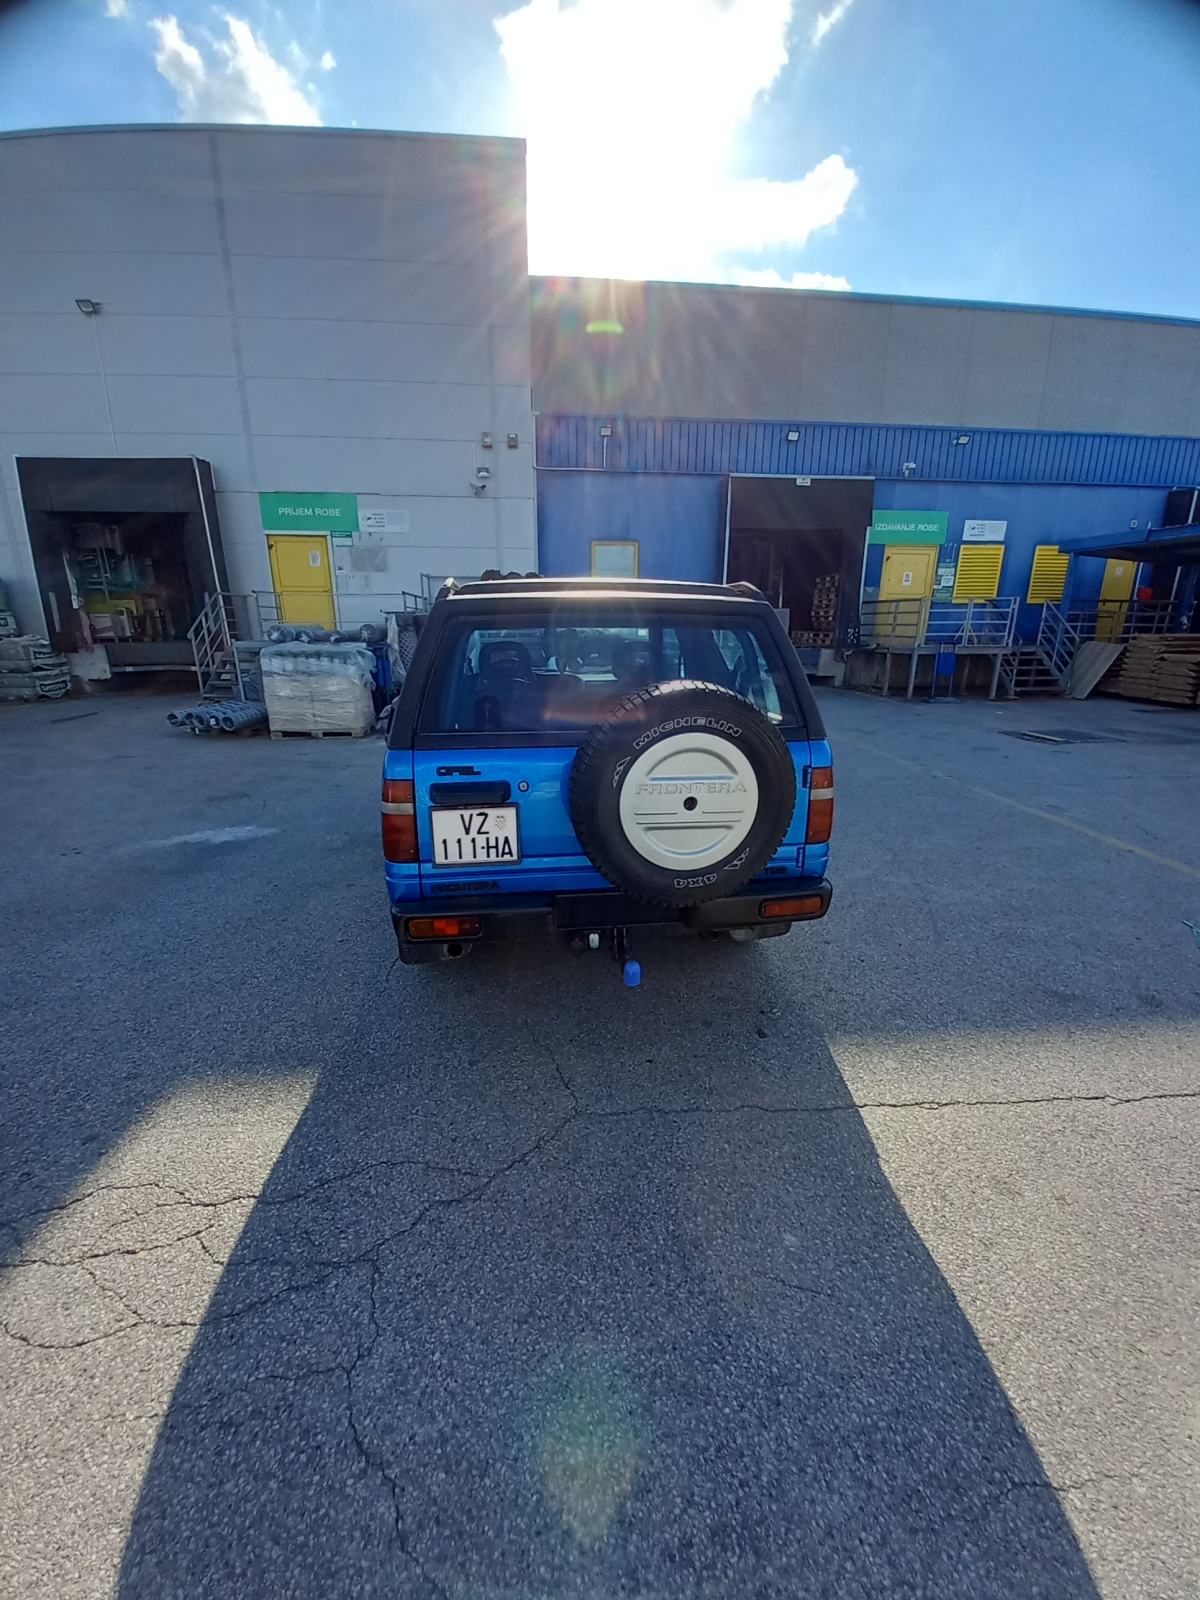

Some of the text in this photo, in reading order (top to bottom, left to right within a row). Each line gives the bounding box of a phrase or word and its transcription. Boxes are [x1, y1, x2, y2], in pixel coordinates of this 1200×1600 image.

[278, 507, 341, 517] PRIJEM ROBE
[874, 523, 940, 532] IZDAVANJE ROBE
[633, 716, 742, 750] MICHELIN
[635, 782, 747, 796] FRONTERA
[460, 812, 489, 836] VZ
[442, 836, 514, 860] 111-HA
